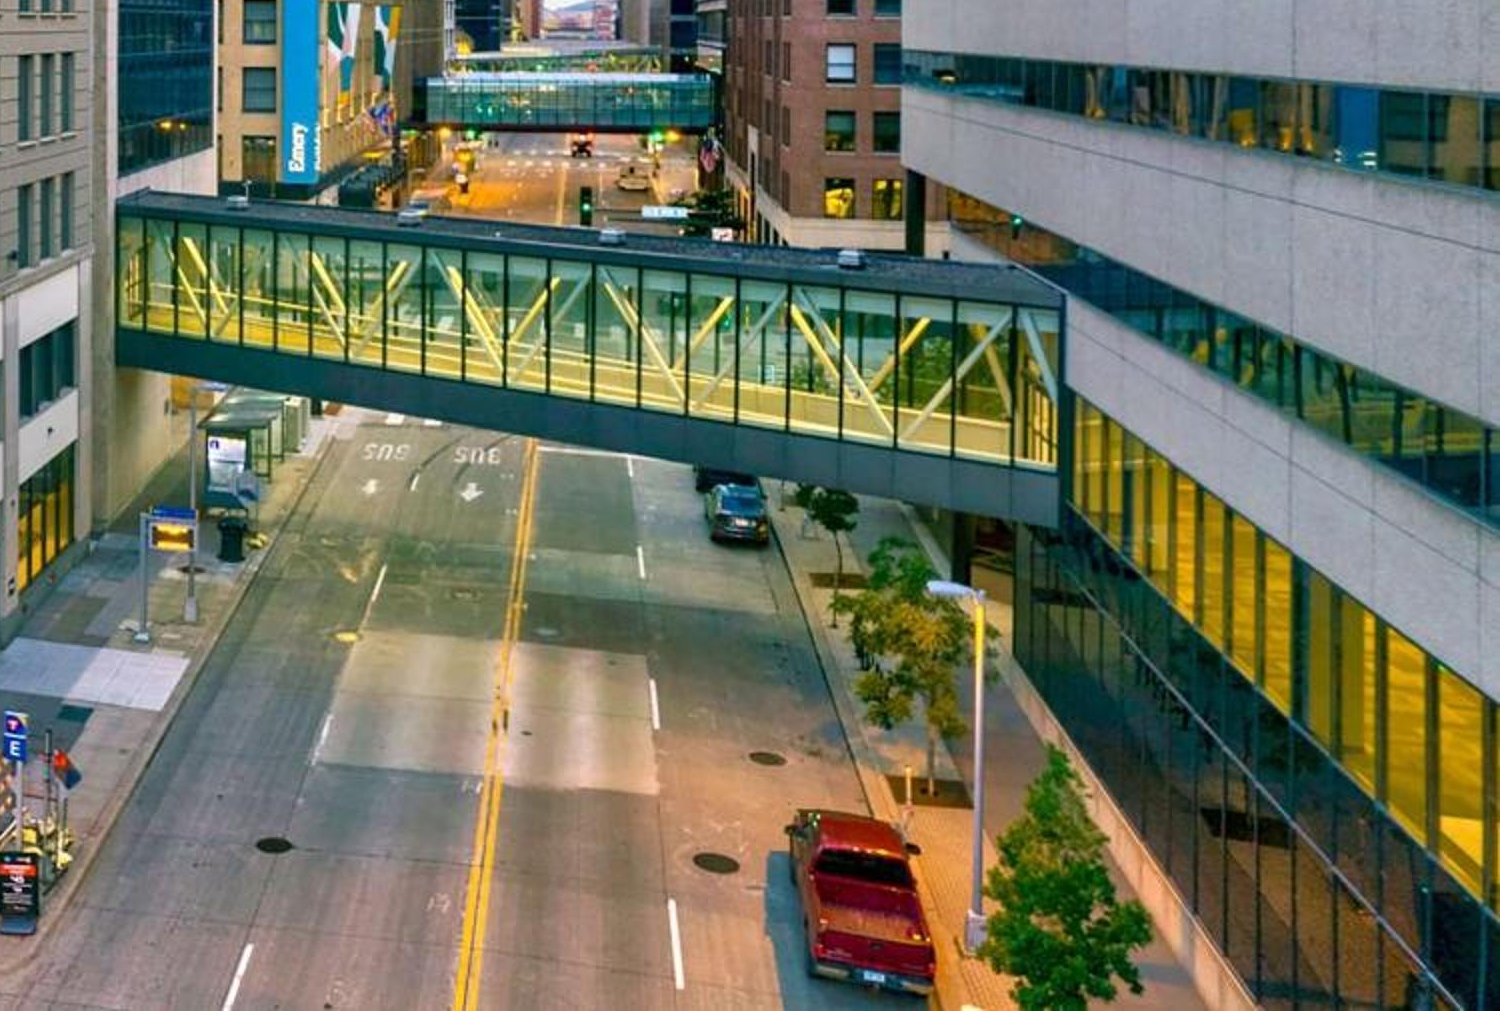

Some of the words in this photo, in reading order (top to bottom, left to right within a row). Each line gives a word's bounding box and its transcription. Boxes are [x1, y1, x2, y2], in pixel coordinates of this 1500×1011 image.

[362, 443, 411, 461] BUS
[453, 446, 502, 464] BUS
[10, 740, 21, 757] E
